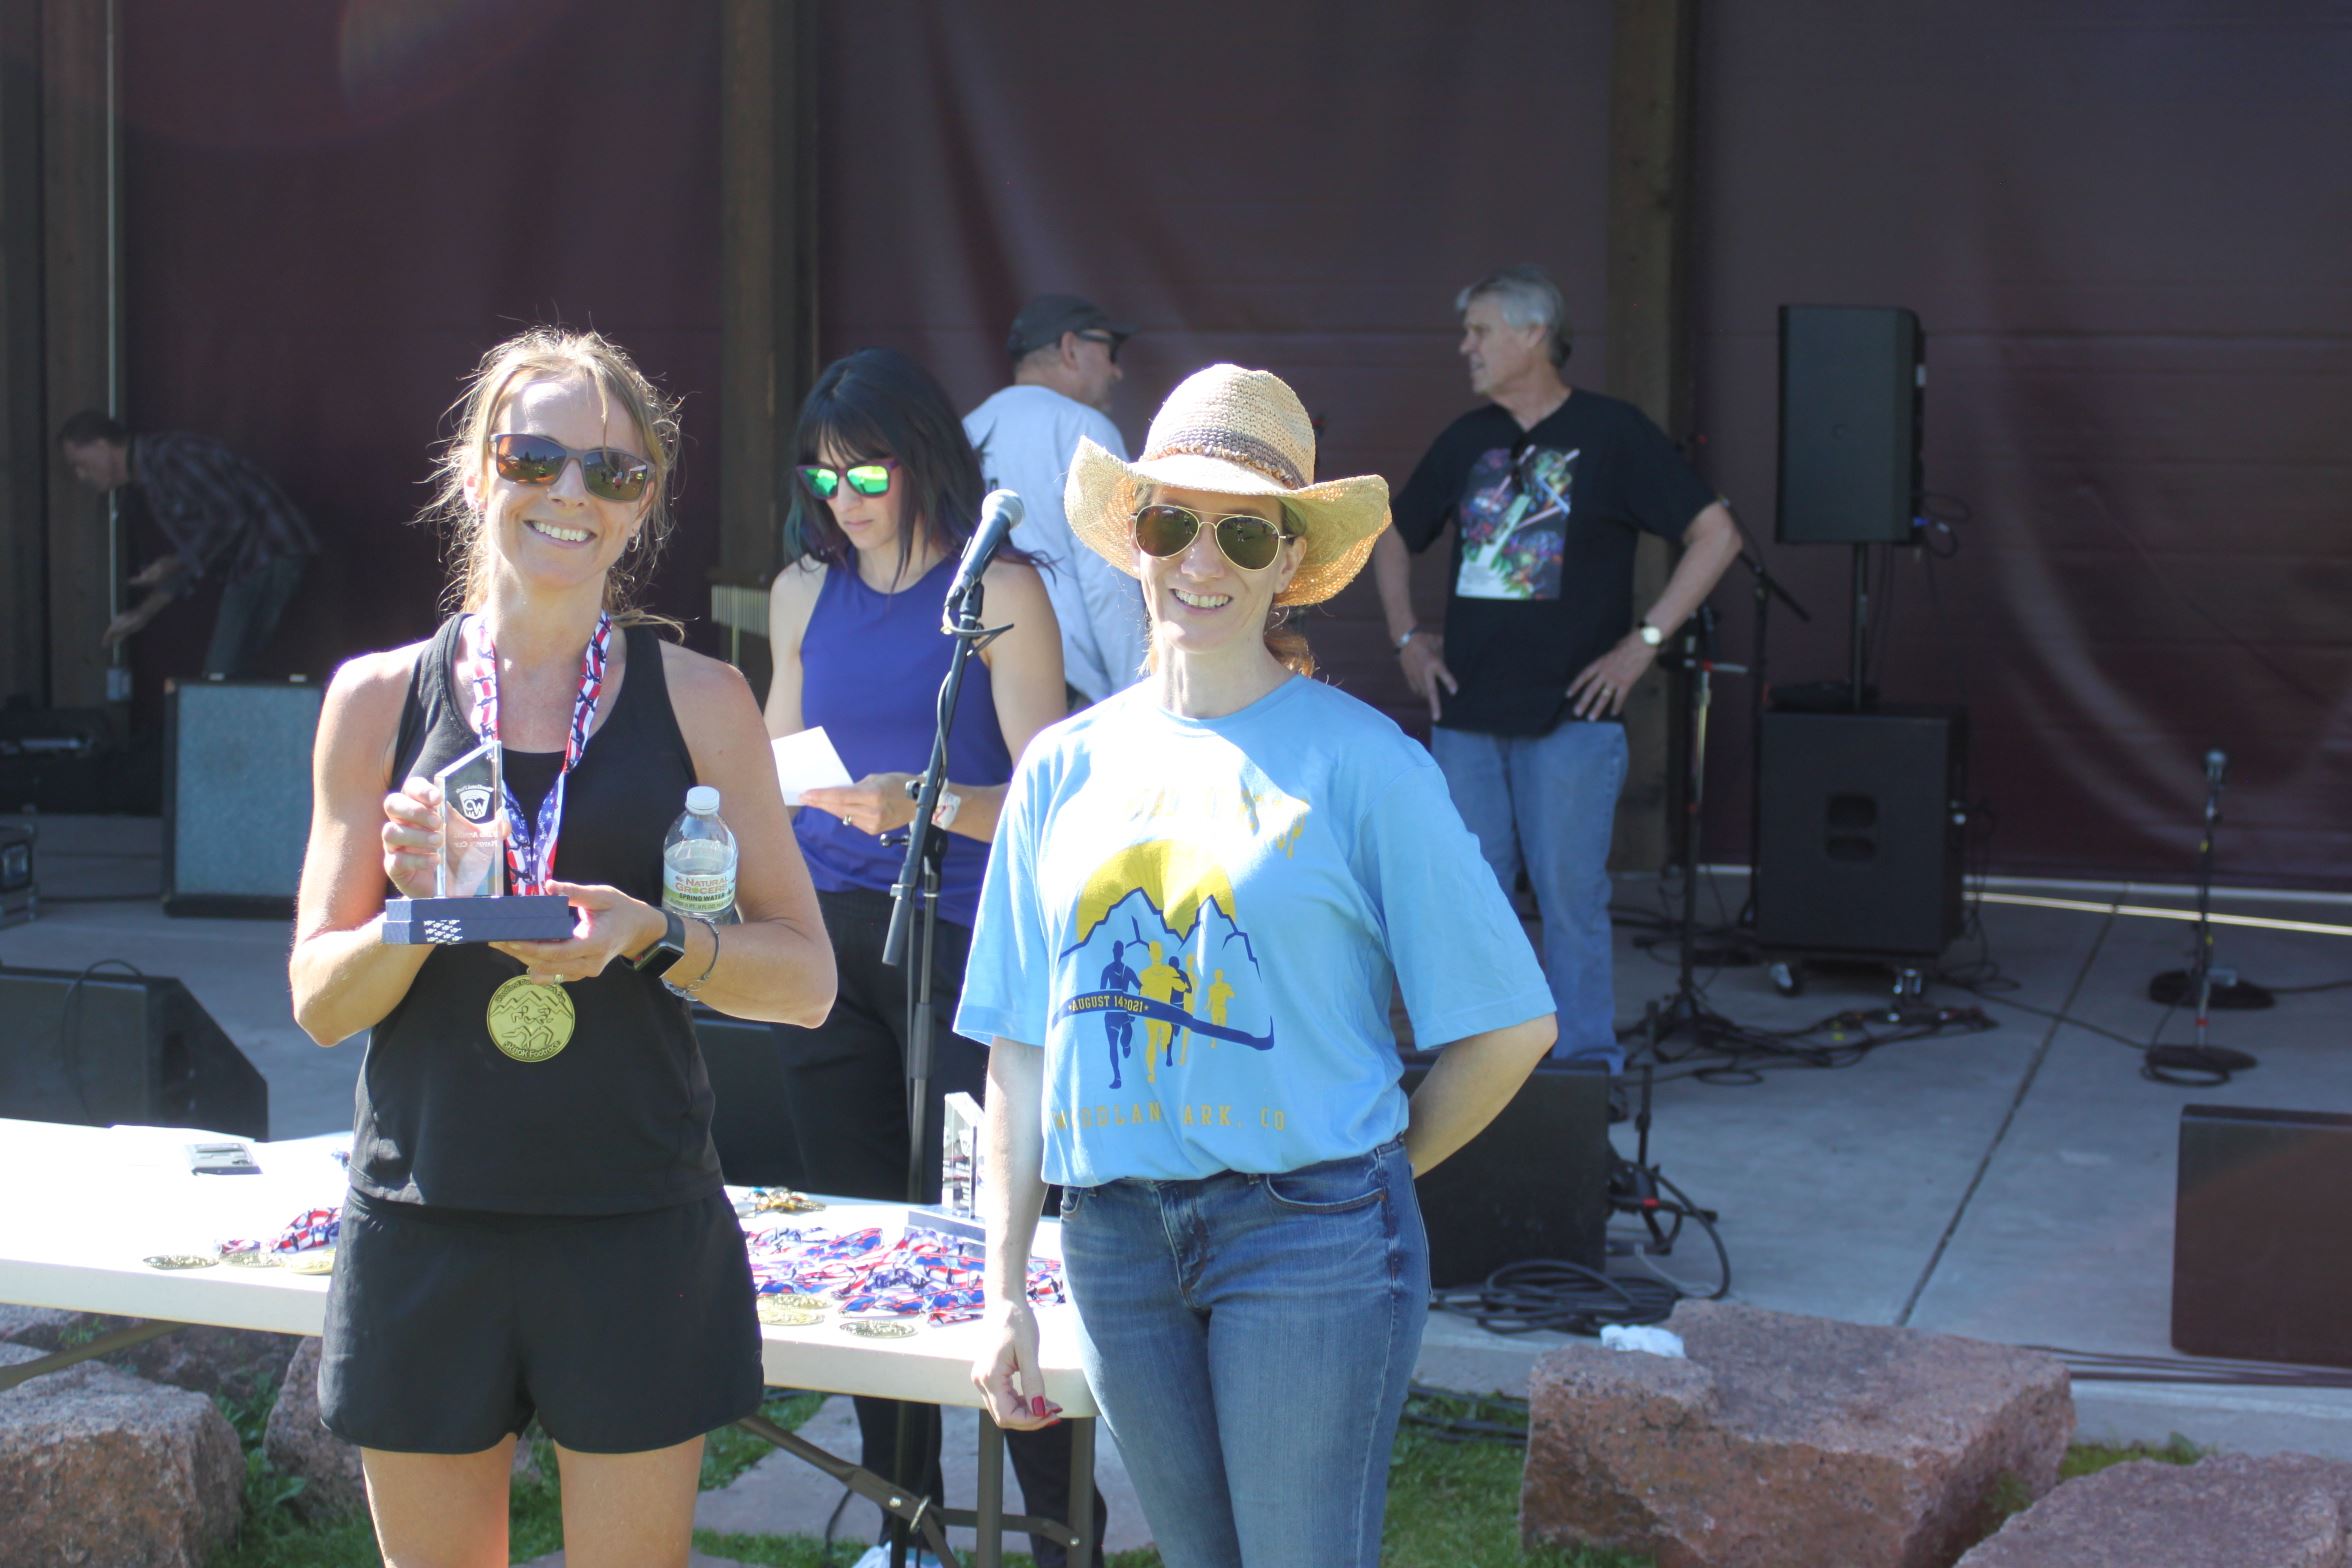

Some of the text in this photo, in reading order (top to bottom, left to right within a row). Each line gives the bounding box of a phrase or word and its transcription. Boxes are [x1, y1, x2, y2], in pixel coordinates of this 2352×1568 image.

[685, 875, 728, 887] NATURAL
[679, 892, 726, 902] SPRING WATER
[1071, 995, 1110, 1011] AUGUST
